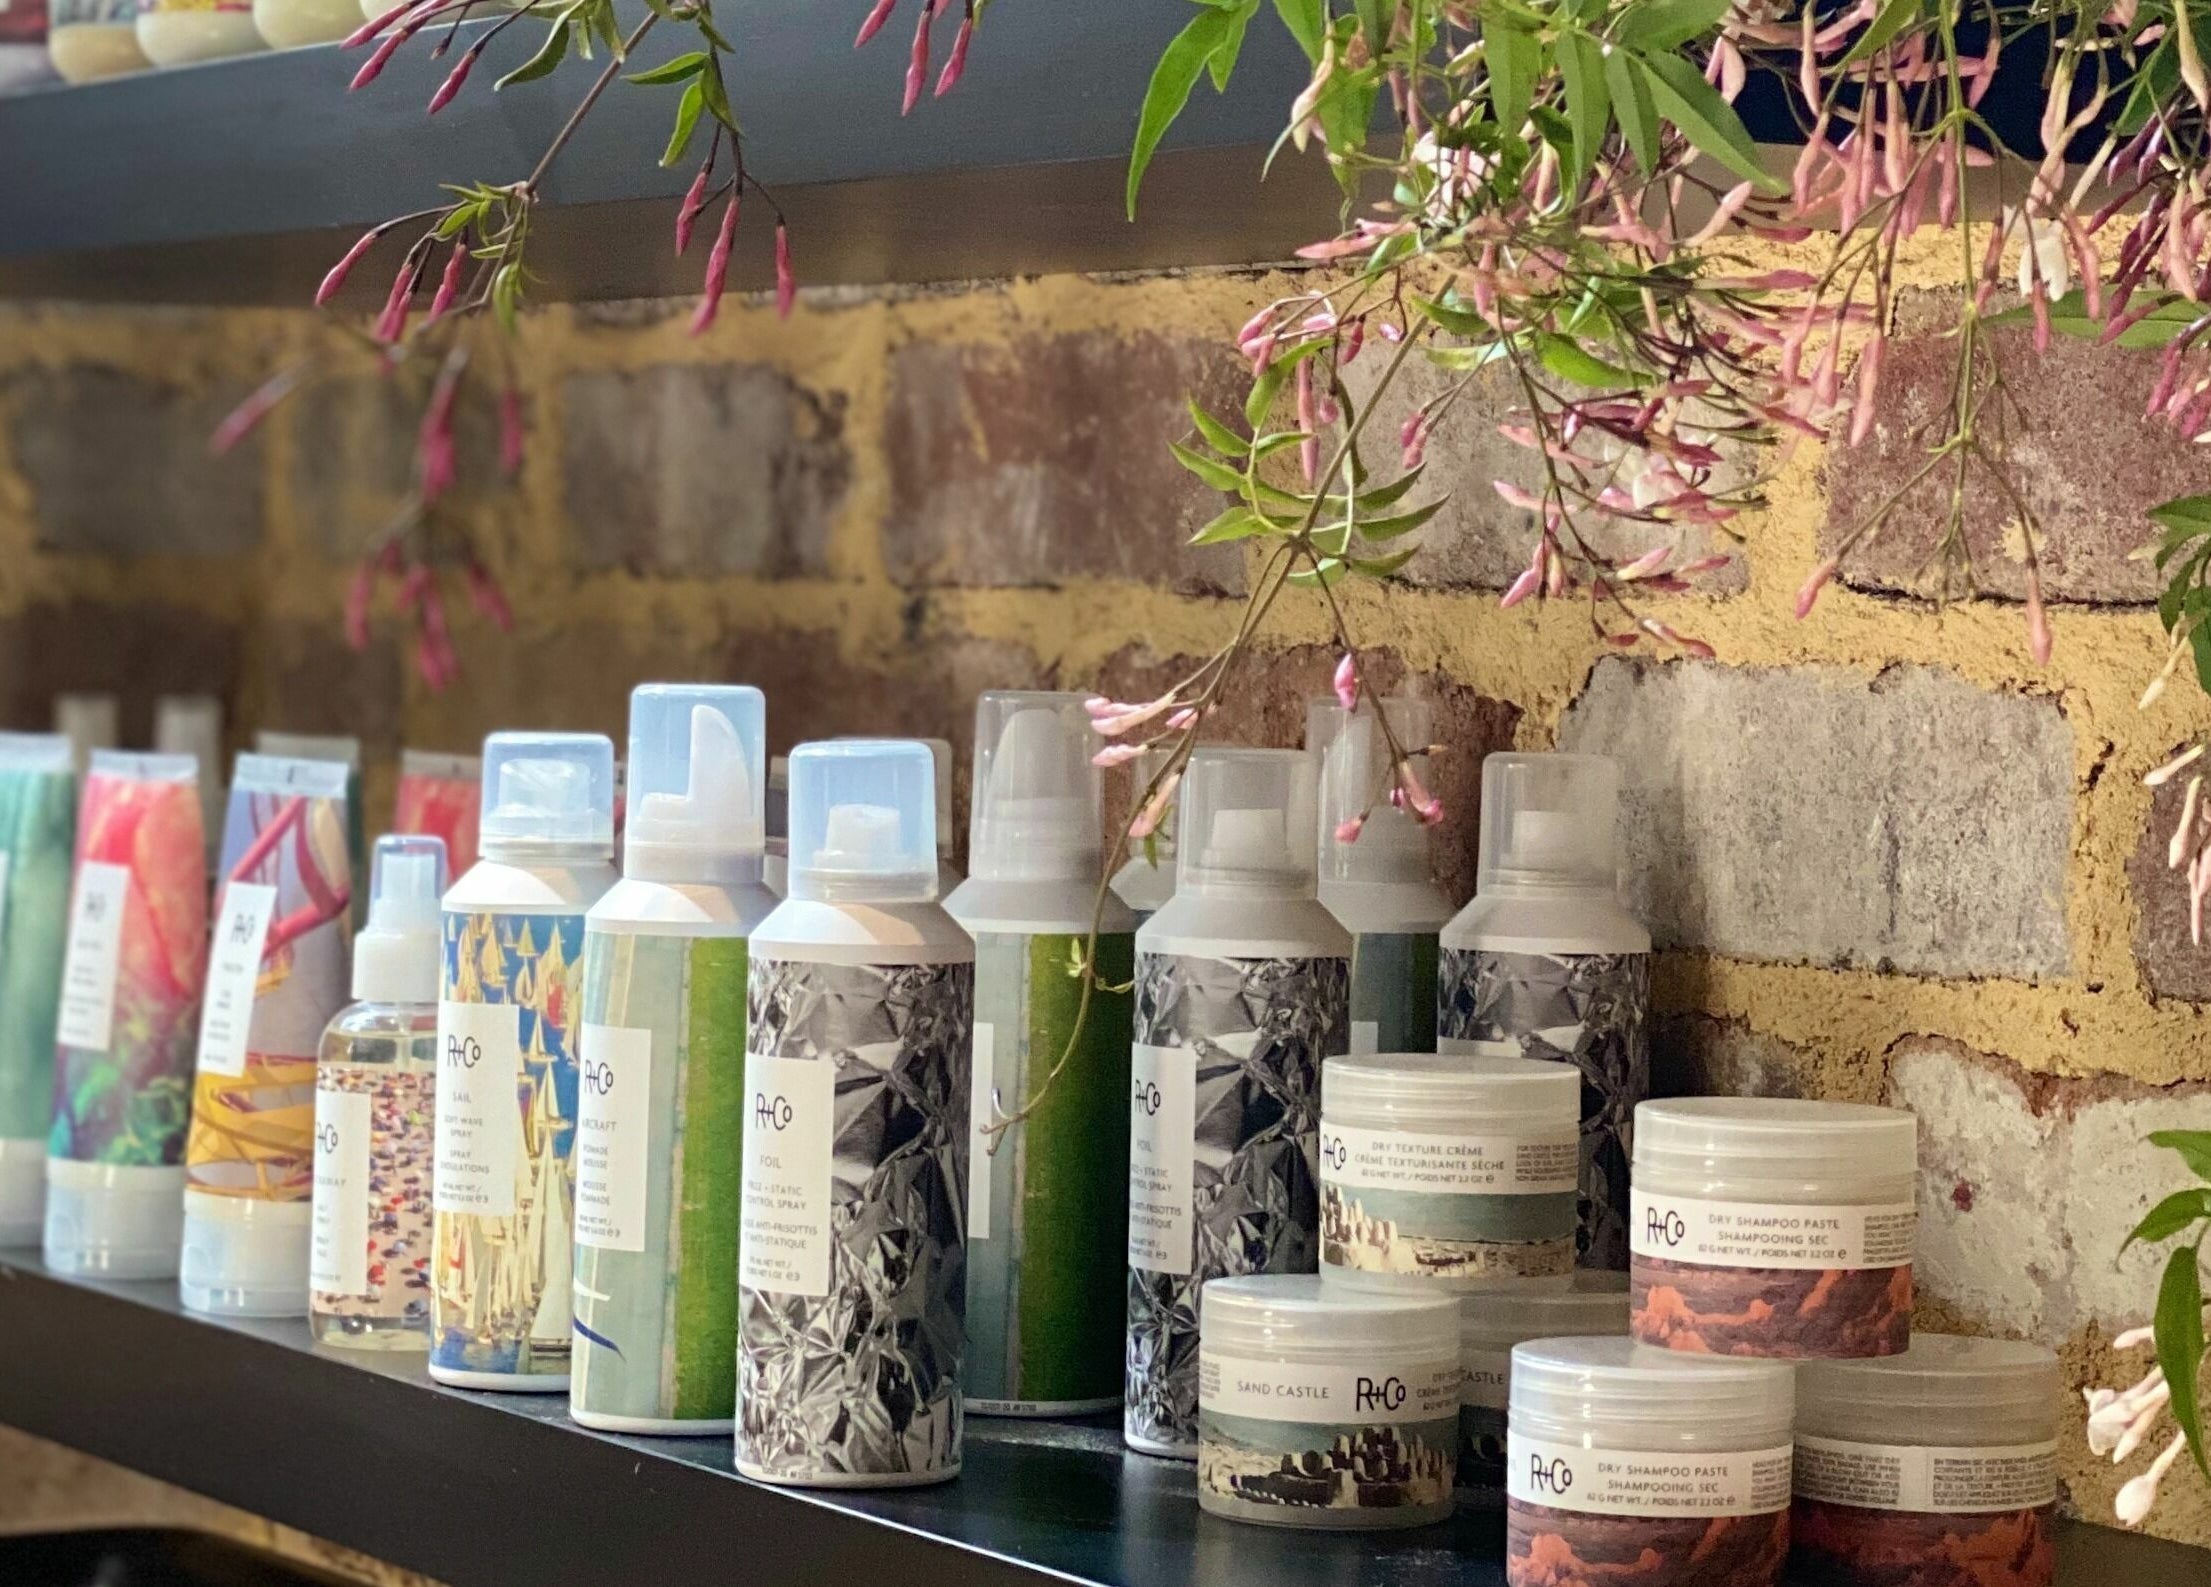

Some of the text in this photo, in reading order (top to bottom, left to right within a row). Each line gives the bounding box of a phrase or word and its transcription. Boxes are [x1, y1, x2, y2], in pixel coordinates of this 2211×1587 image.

[447, 1034, 481, 1068] R+Co
[584, 1059, 613, 1095] R+Co
[453, 1091, 472, 1104] SAIL
[1135, 1079, 1161, 1116] R+Co
[756, 1093, 792, 1131] R+Co
[1323, 1134, 1346, 1170] R+Co
[1372, 1141, 1483, 1156] DRY TEXTURE CRÈME
[760, 1154, 782, 1169] FOIL
[1388, 1156, 1467, 1170] TEXTURISANTE
[771, 1184, 802, 1196] STATIC
[777, 1200, 806, 1210] SPRAY
[1647, 1207, 1685, 1246] R+Co
[1709, 1213, 1841, 1230] DRY SHAMPOO PASTE
[1718, 1231, 1829, 1245] SHAMPOOING SEC
[1719, 1245, 1734, 1254] NET
[1761, 1249, 1789, 1257] POIDS
[1791, 1249, 1807, 1258] NET
[1238, 1380, 1329, 1399] SAND CASTLE
[1356, 1377, 1406, 1412] R+Co
[1531, 1453, 1572, 1494] R+Co
[1598, 1462, 1728, 1477] DRY SHAMPOO PASTE
[1608, 1479, 1719, 1493] SHAMPOOING SEC
[1607, 1495, 1624, 1503] NET
[1652, 1497, 1679, 1506] POIDS
[1681, 1498, 1697, 1506] NET
